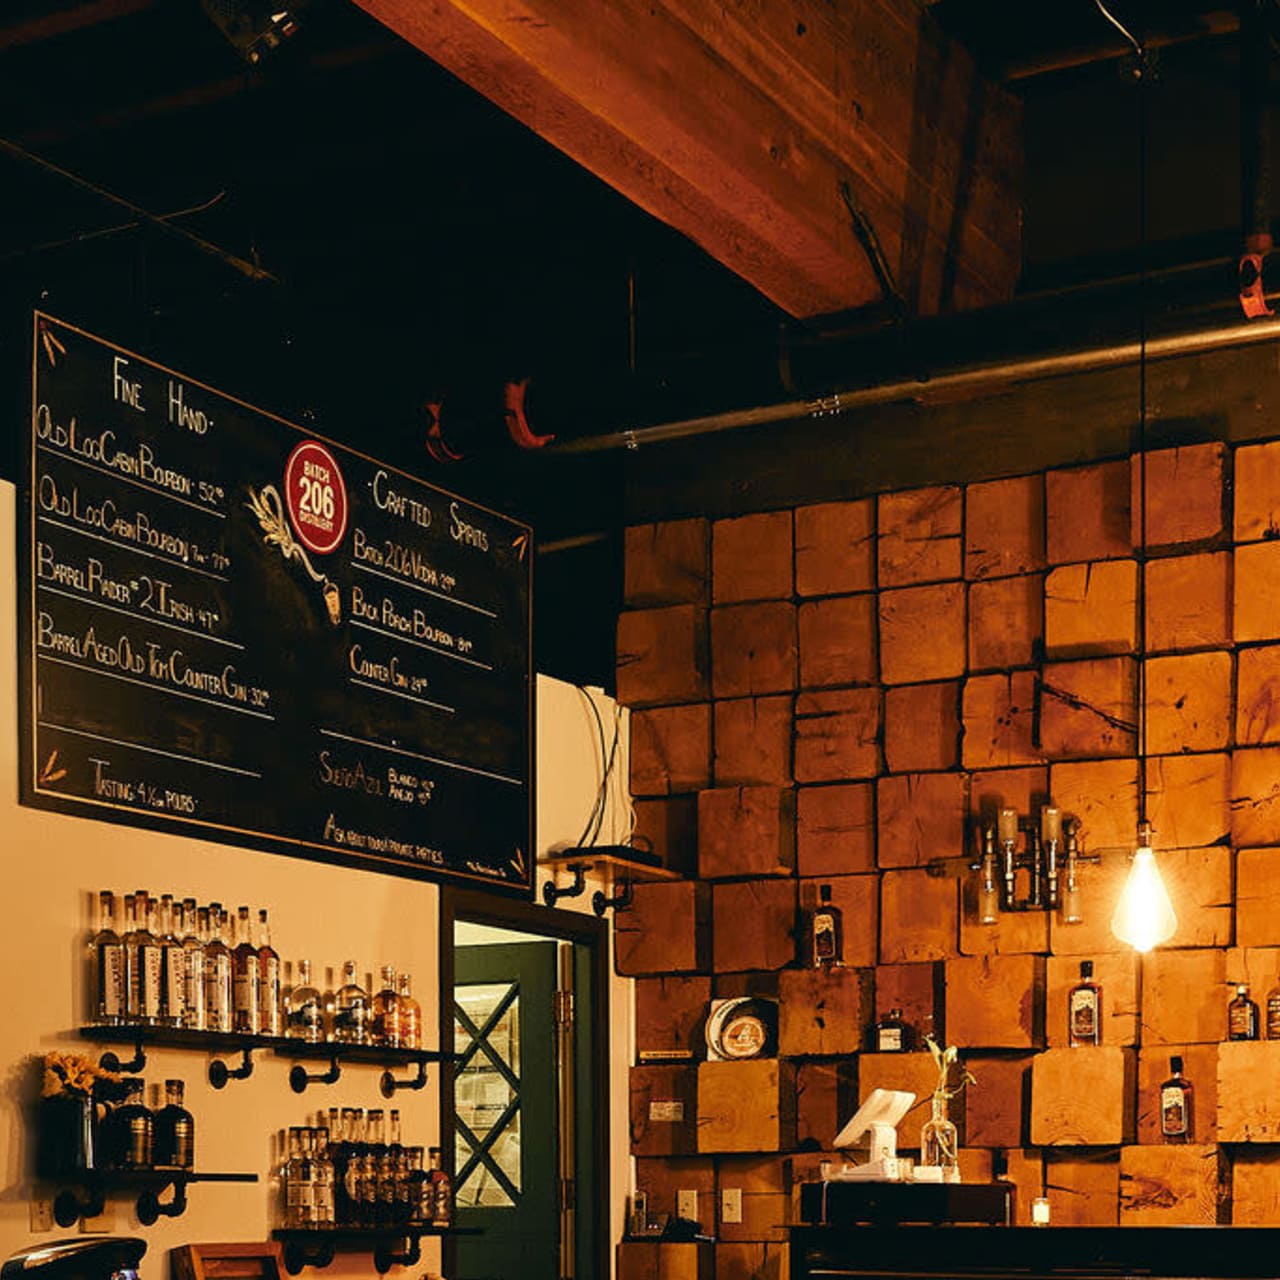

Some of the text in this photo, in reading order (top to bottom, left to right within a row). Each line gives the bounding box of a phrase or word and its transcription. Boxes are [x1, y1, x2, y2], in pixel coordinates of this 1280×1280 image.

[114, 356, 208, 434] FINE HAND
[36, 404, 68, 446] OLD
[70, 416, 100, 461] LOG
[299, 476, 334, 519] 206
[303, 460, 330, 483] BATCH
[39, 474, 70, 517] OLD
[73, 487, 100, 527] LOG
[373, 470, 489, 552] CRAFTED SPIRITS
[37, 541, 88, 591] BARREL
[384, 541, 411, 576] 206
[38, 612, 83, 658] BARREL
[83, 627, 118, 666] AGED
[119, 636, 144, 673] OLD
